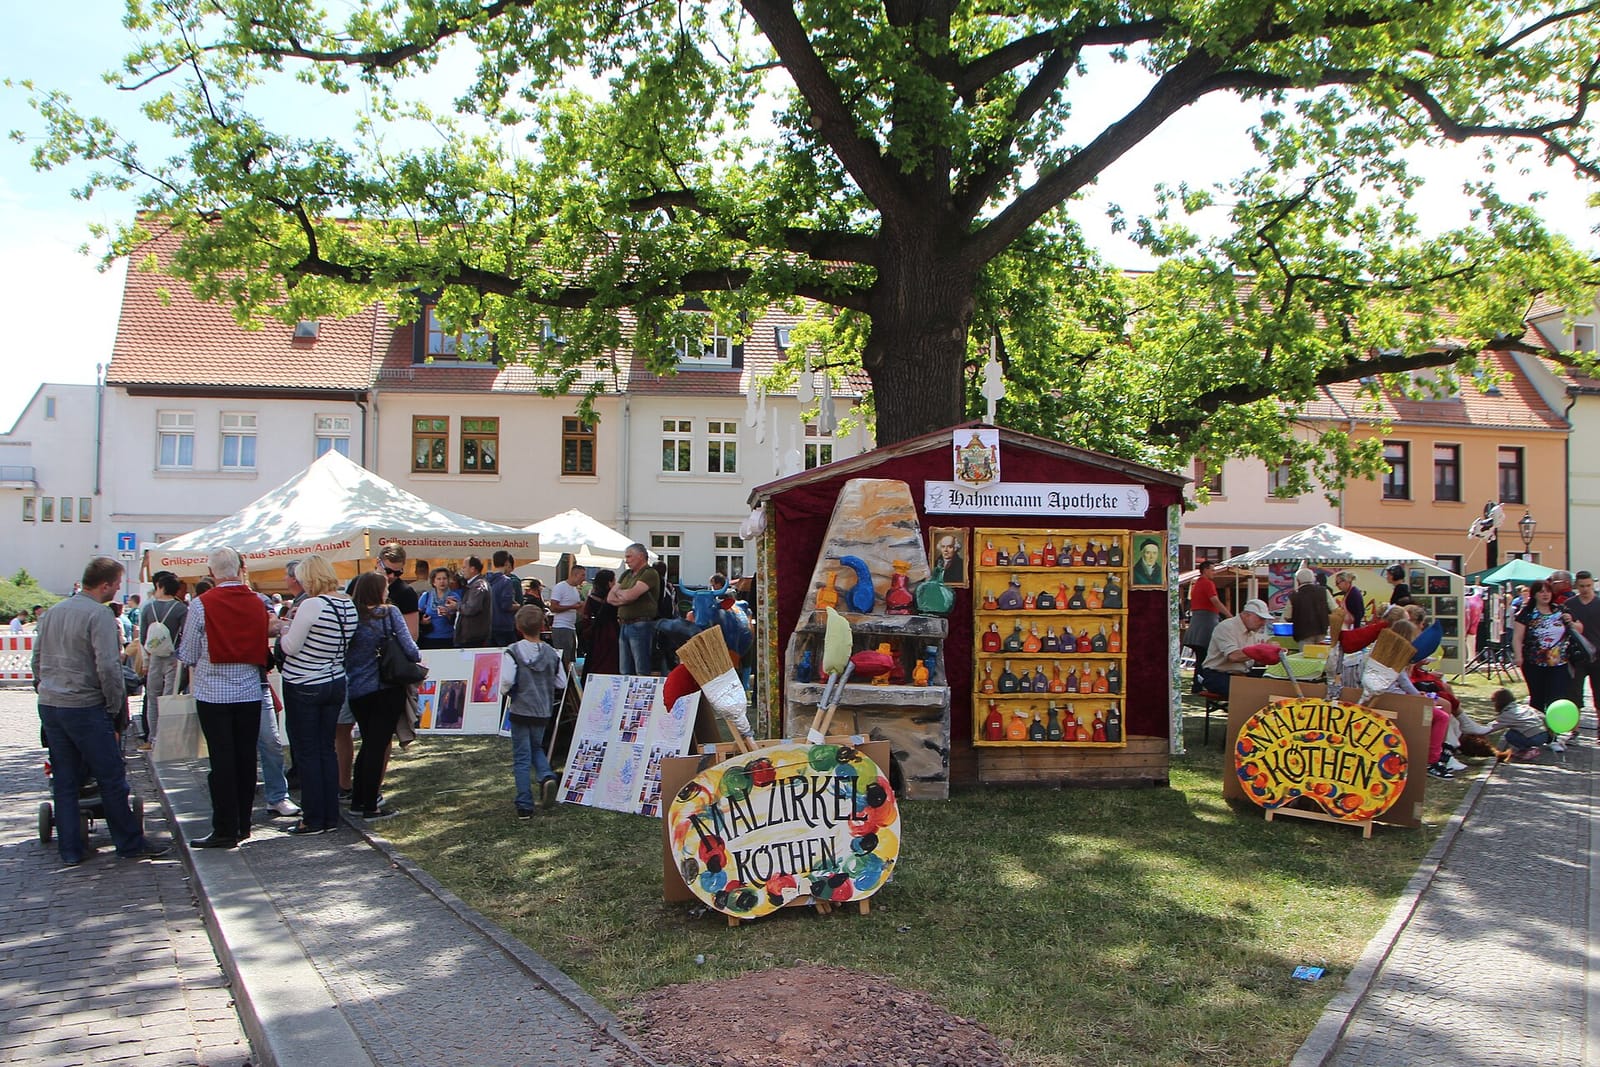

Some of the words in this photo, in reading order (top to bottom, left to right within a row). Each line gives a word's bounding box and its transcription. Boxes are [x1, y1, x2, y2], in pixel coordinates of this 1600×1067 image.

[949, 488, 1042, 510] Hahnemann
[1048, 491, 1119, 511] Apotheke
[249, 551, 266, 560] aus
[453, 539, 467, 547] aus
[1244, 705, 1388, 757] MALZIRKEL
[1258, 744, 1379, 790] KÖTHEN
[688, 775, 868, 852] MALZIRKEL
[732, 835, 840, 889] KÖTHEN
